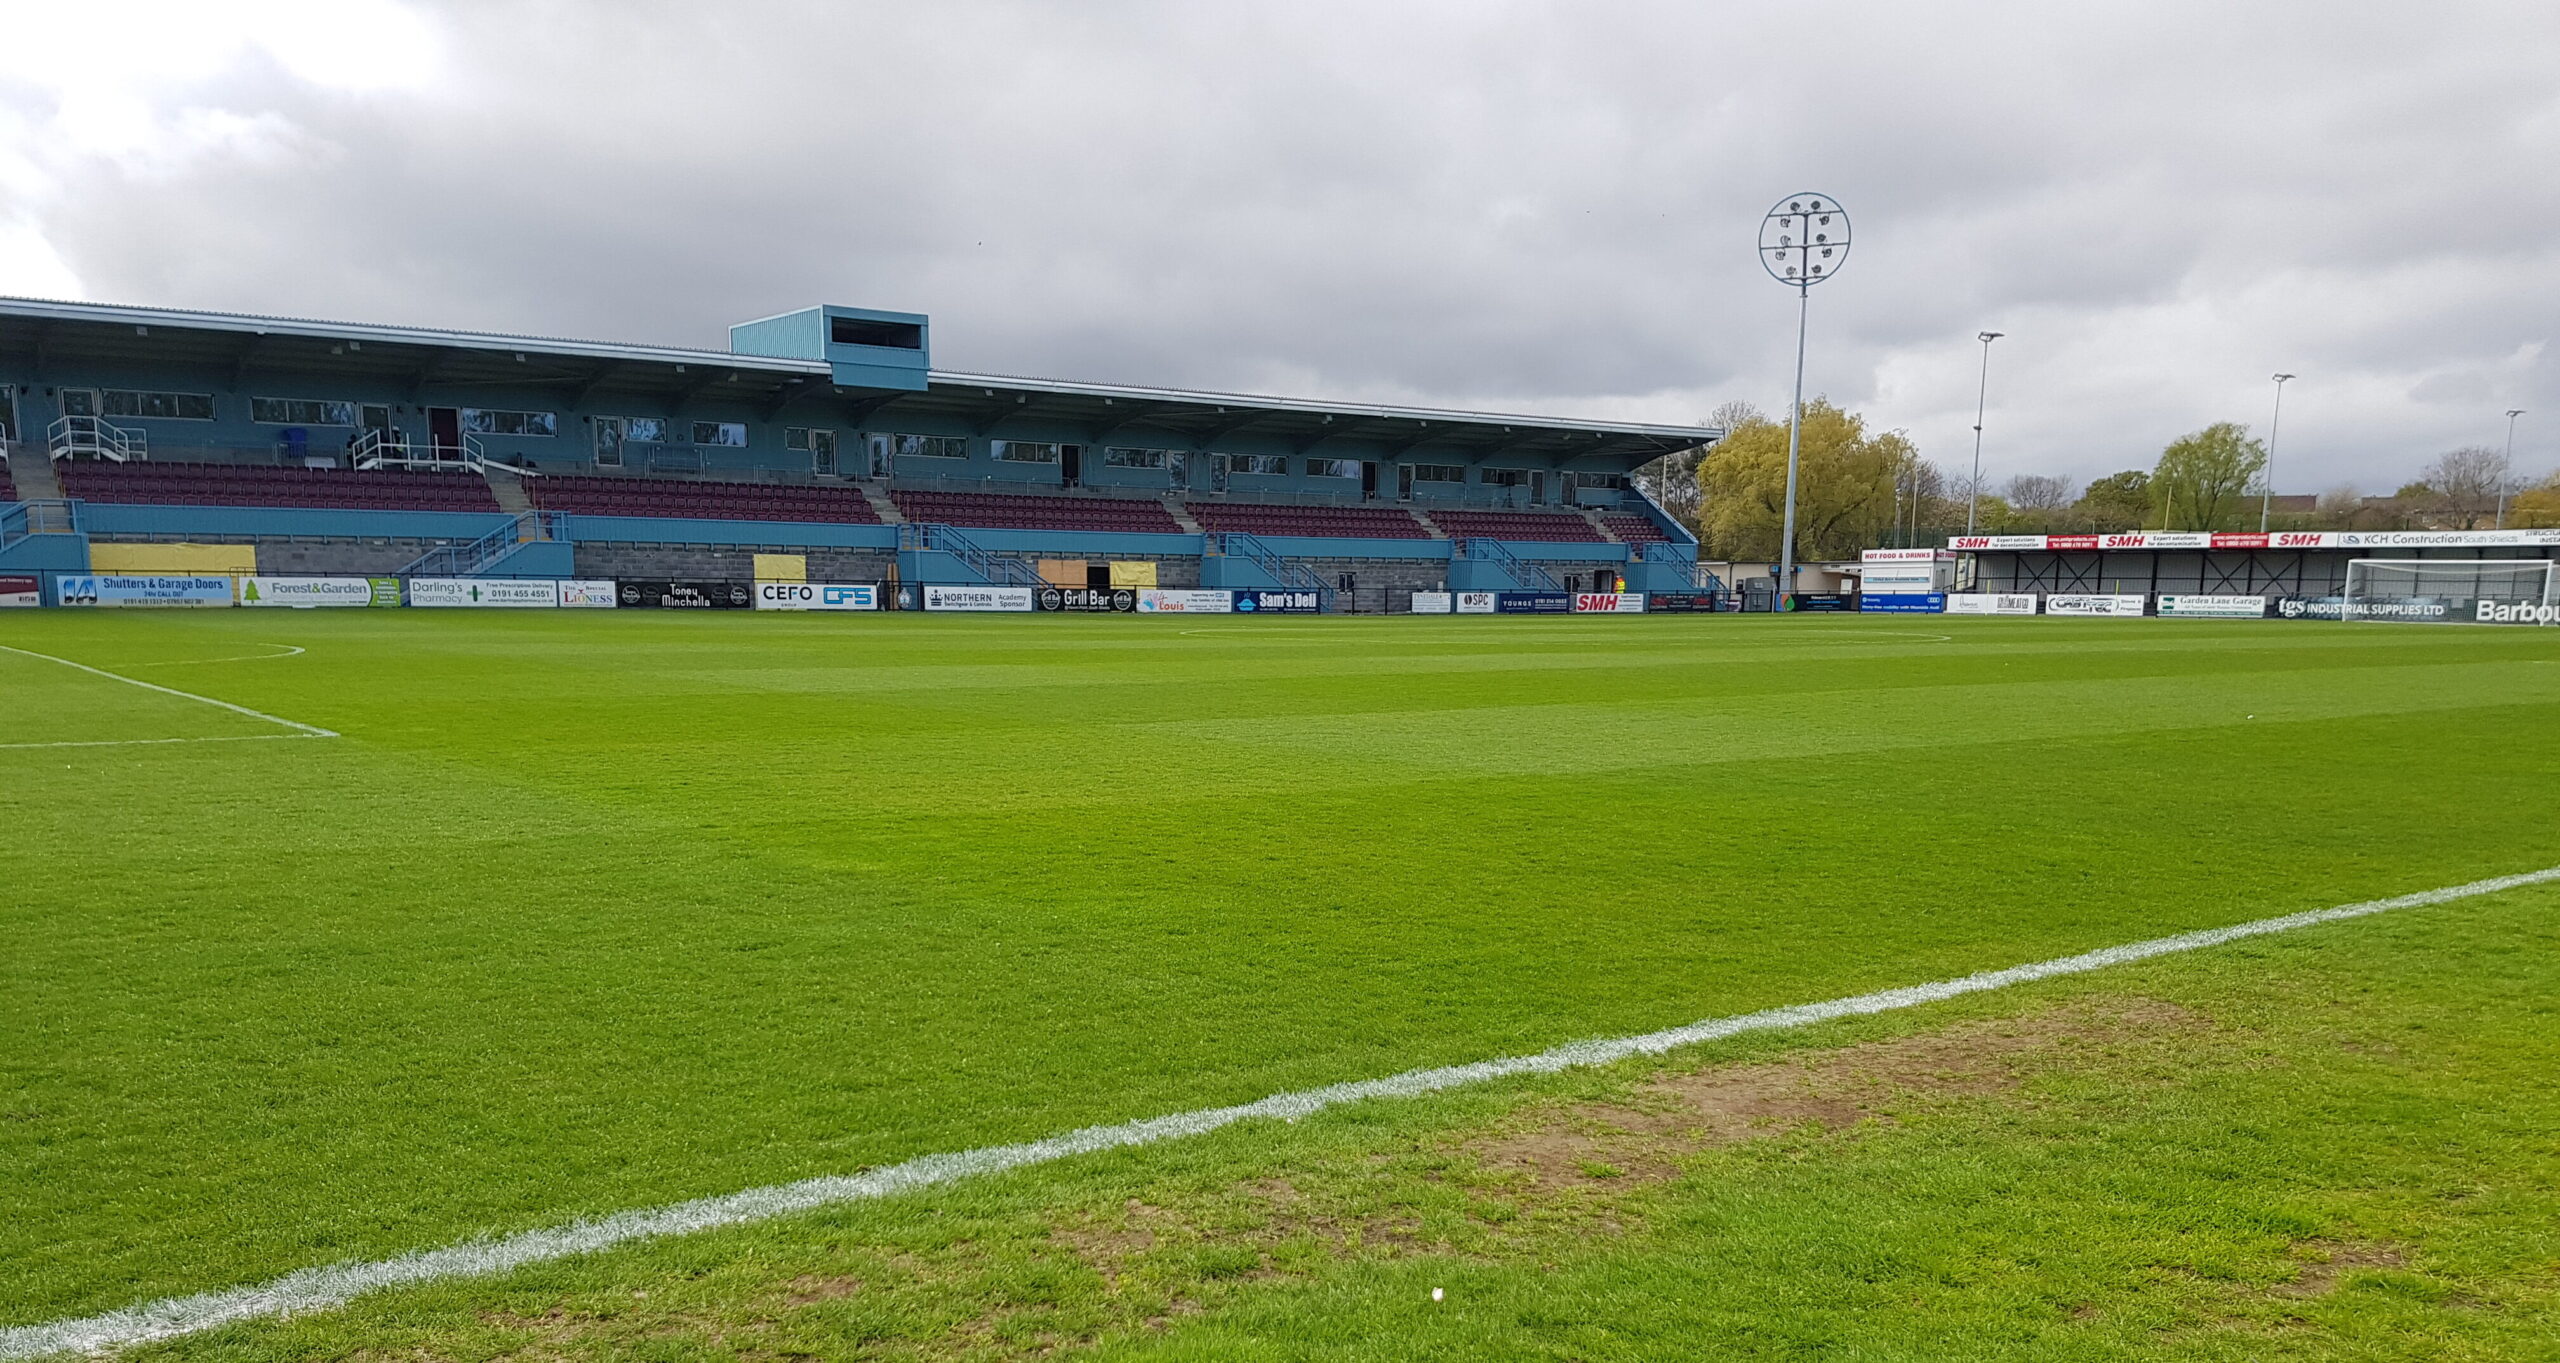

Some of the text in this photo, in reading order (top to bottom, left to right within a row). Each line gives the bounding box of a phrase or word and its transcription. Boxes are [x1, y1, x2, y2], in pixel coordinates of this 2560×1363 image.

[1956, 538, 1990, 548] SMH
[2106, 536, 2145, 546] SMH
[2278, 534, 2322, 546] SMH
[2364, 534, 2388, 544] KCH
[2392, 534, 2462, 544] Construction
[104, 578, 224, 591] Shutters & Garage Doors
[272, 582, 368, 594] Forest&Garden
[412, 582, 462, 594] Darling's
[670, 584, 698, 596] Toney
[414, 594, 462, 604] Pharmacy
[564, 591, 612, 603] LIONESS
[763, 586, 812, 600] CEFO
[823, 587, 872, 604] CFS
[944, 594, 992, 602] NORTHERN
[1064, 590, 1087, 605] Grill
[1090, 590, 1110, 606] Bar
[662, 595, 710, 606] Minchella
[1160, 601, 1184, 610] Louis
[1260, 592, 1316, 608] Sam's Deli
[1473, 594, 1488, 606] SPC
[1577, 594, 1618, 610] SMH
[2232, 598, 2262, 606] Garage
[2278, 598, 2444, 617] tgs INDUSTRIAL SUPPLIES LTD
